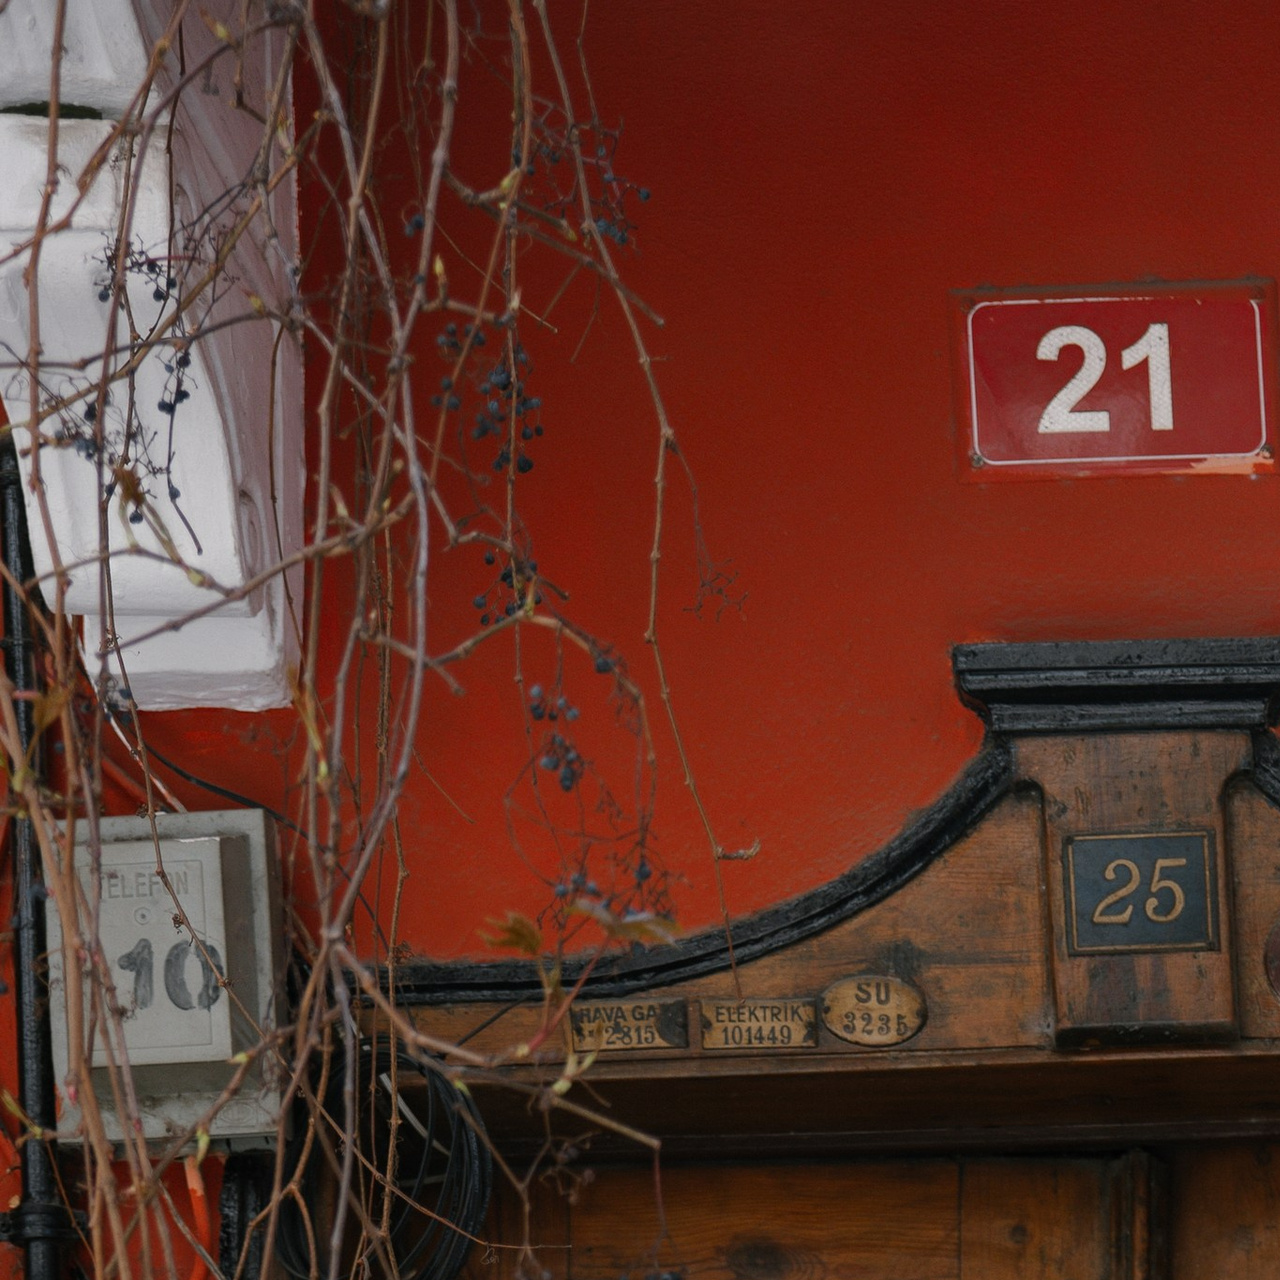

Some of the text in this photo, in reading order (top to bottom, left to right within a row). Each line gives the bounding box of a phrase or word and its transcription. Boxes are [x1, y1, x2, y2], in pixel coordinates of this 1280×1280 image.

[1036, 322, 1174, 434] 21
[1090, 857, 1188, 925] 25
[117, 937, 226, 1012] 10
[854, 981, 891, 1006] SU
[580, 1005, 628, 1024] HAVA
[715, 1002, 804, 1023] ELEKTRİK
[842, 1011, 909, 1037] 3235
[721, 1024, 793, 1046] 101449
